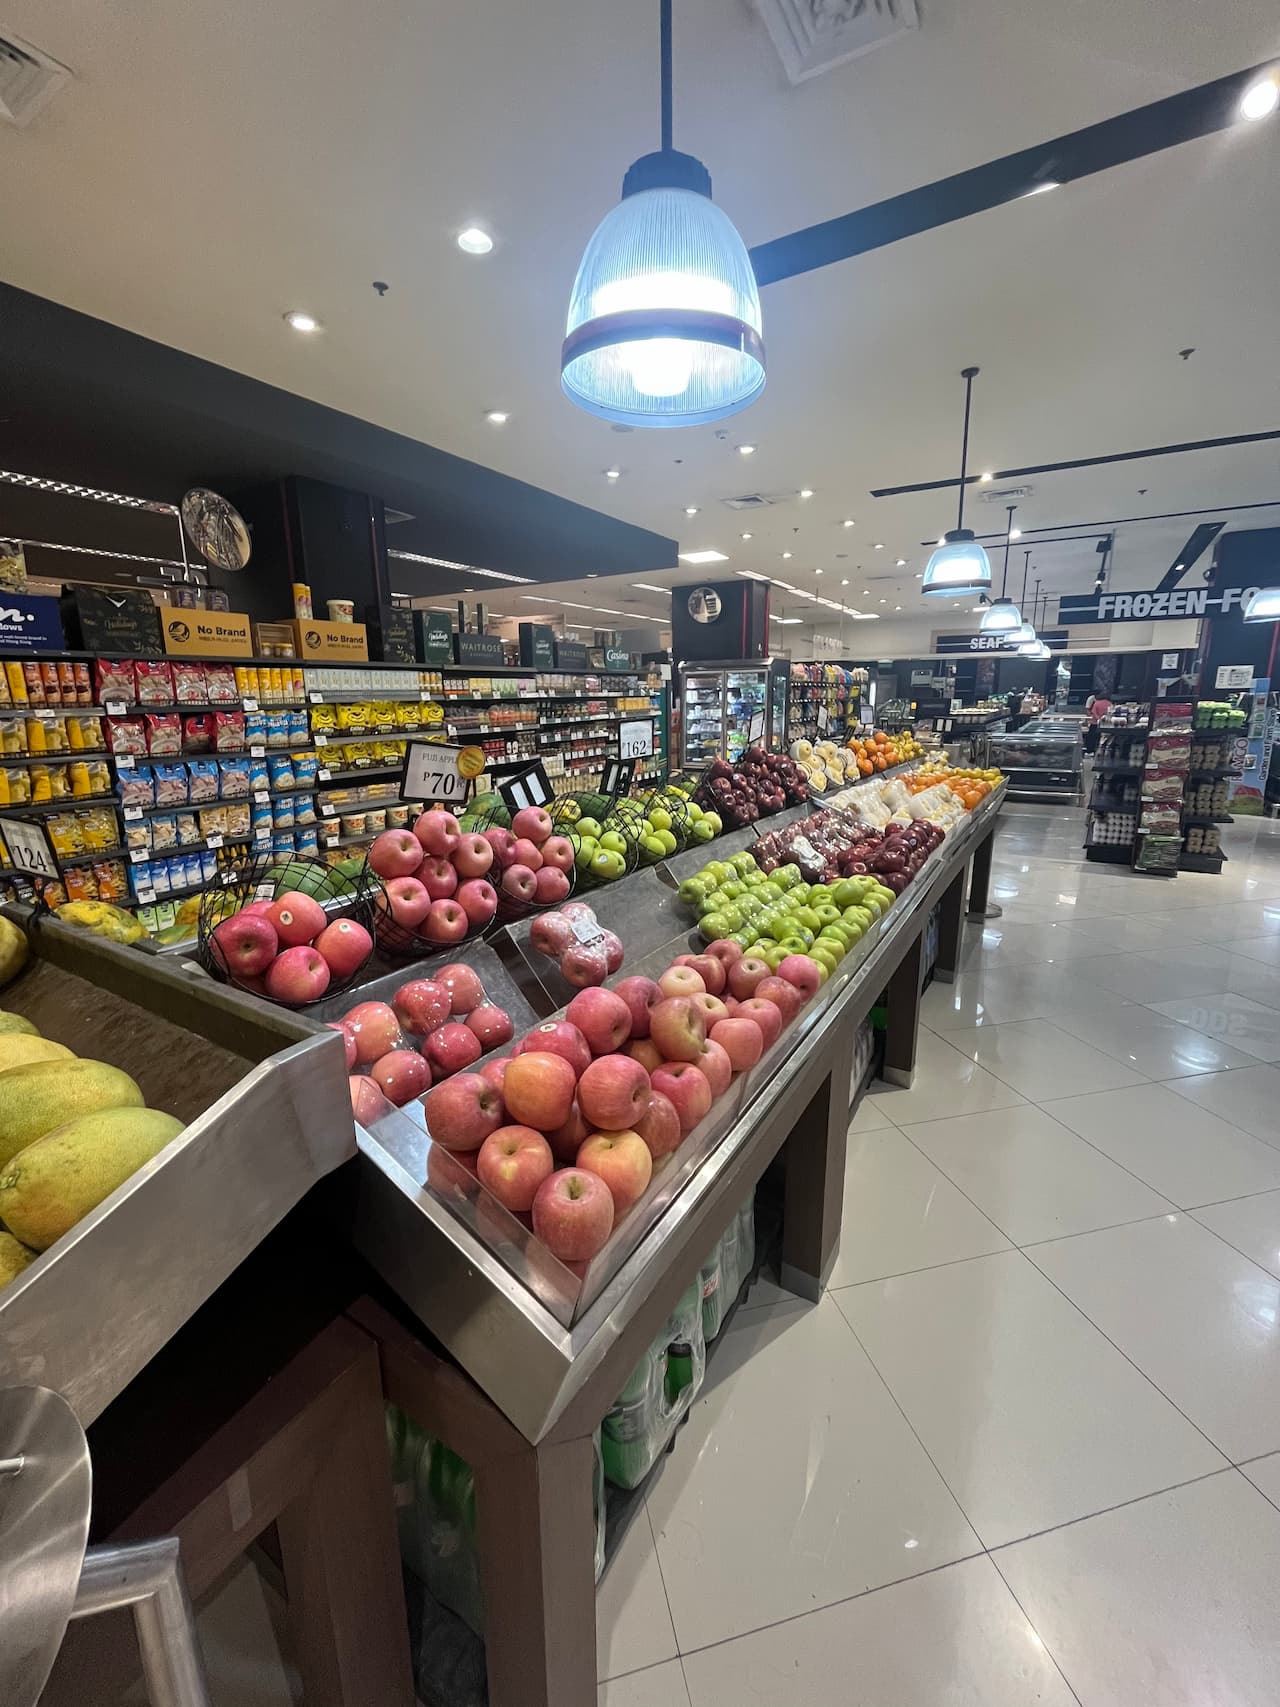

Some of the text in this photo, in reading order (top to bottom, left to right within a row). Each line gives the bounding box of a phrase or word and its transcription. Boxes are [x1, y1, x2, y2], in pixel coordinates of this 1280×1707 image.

[1097, 590, 1208, 619] FROZEN
[197, 625, 246, 637] No Brand
[327, 634, 364, 644] No Brand
[462, 642, 501, 653] WAITROSE
